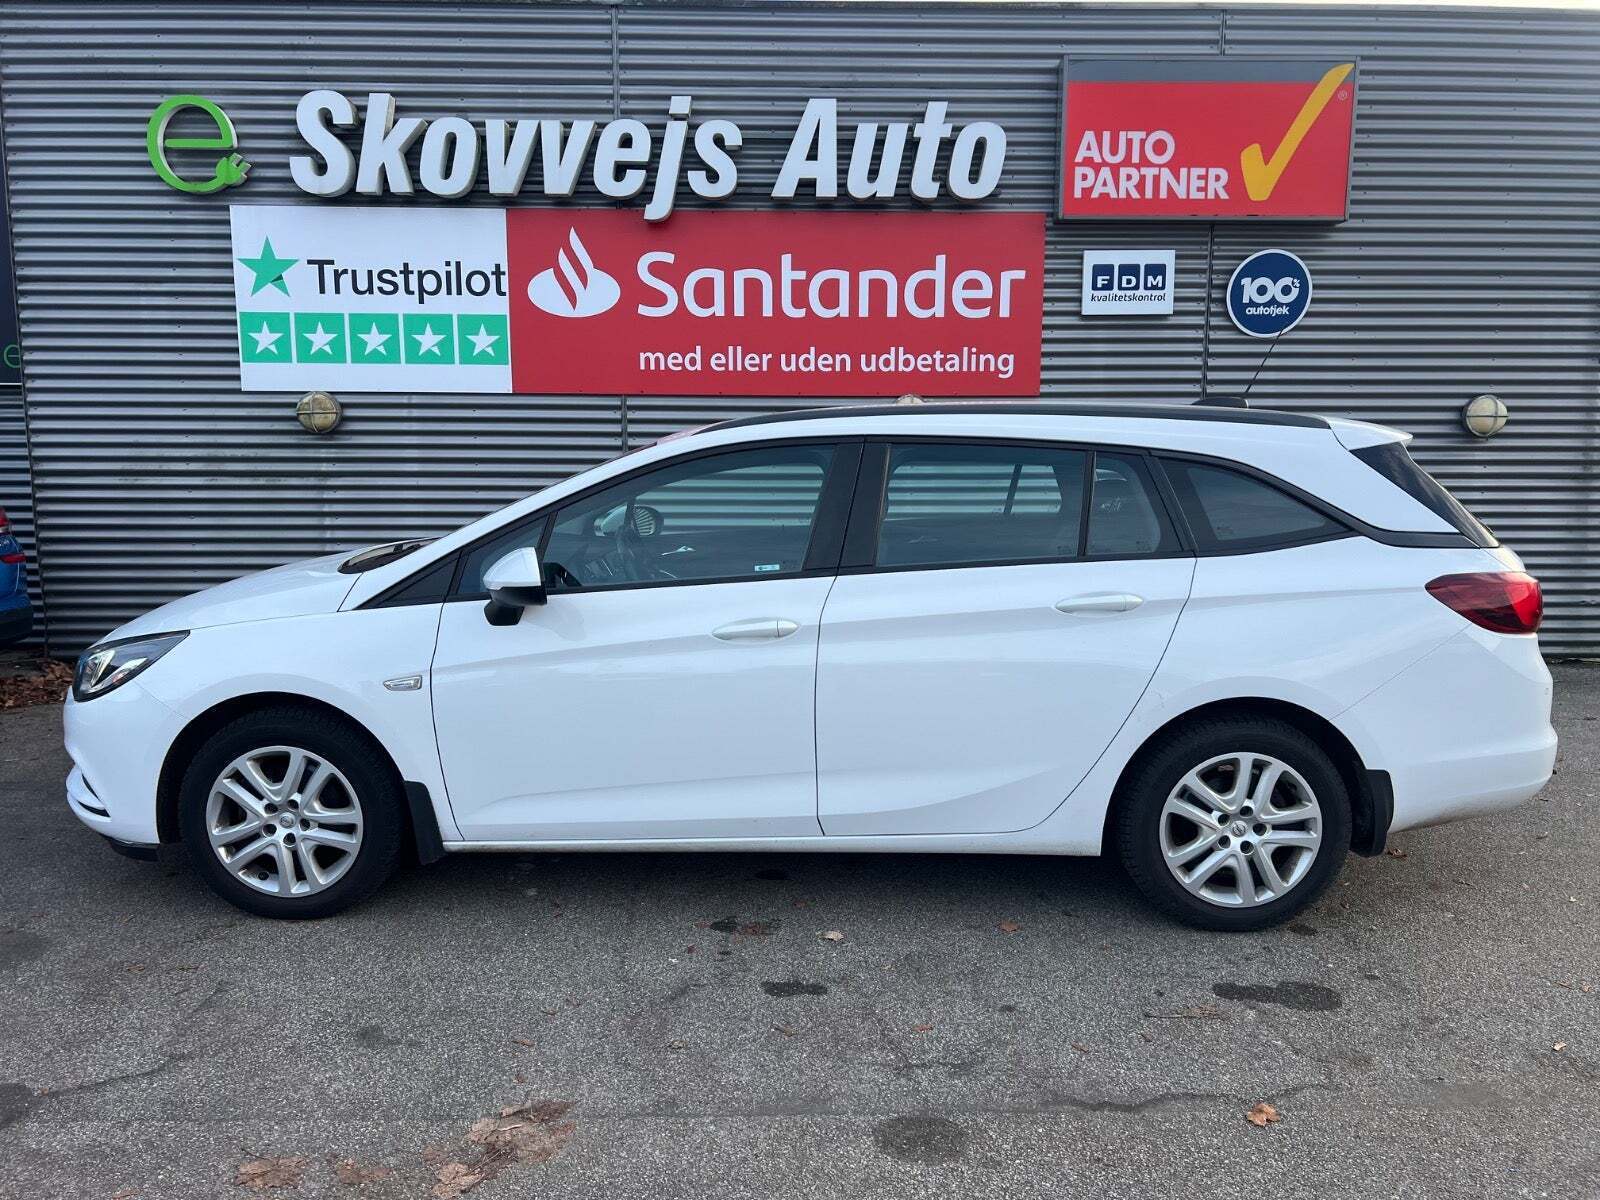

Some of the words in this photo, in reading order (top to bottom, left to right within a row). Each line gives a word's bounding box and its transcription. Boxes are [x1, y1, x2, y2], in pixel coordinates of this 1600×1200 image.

[289, 90, 744, 221] Skovvejs
[771, 98, 1008, 200] Auto
[1074, 130, 1176, 165] AUTO
[1073, 166, 1230, 200] PARTNER
[306, 258, 507, 305] Trustpilot
[635, 251, 1027, 319] Santander
[1090, 292, 1167, 303] kvalitetskontrol
[1095, 273, 1164, 289] FDM
[1245, 304, 1290, 317] autotjek
[639, 346, 703, 372] med
[709, 346, 773, 373] eller
[779, 347, 852, 373] uden
[859, 347, 1016, 379] udbetaling
